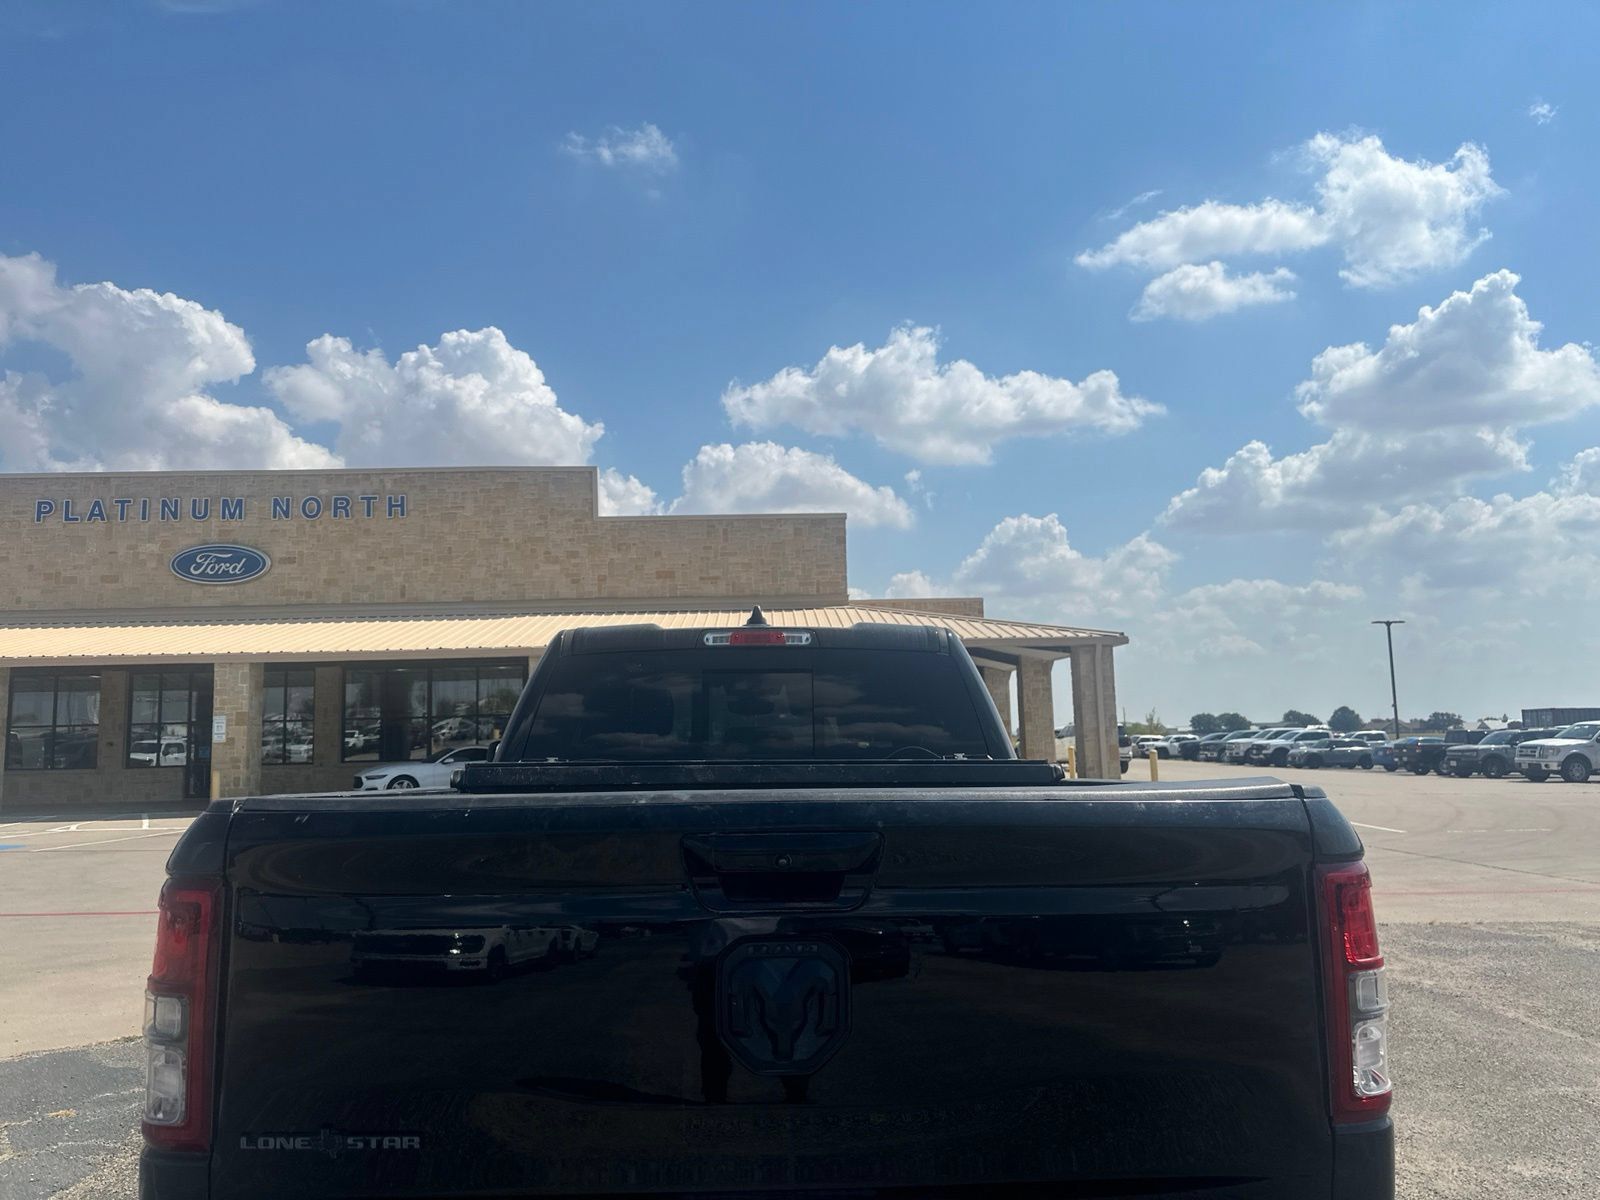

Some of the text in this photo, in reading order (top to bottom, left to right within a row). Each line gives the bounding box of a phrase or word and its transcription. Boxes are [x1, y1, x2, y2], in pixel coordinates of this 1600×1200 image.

[34, 494, 407, 523] PLATINUM NORTH
[190, 552, 246, 575] Ford
[240, 1135, 421, 1150] LONE STAR
